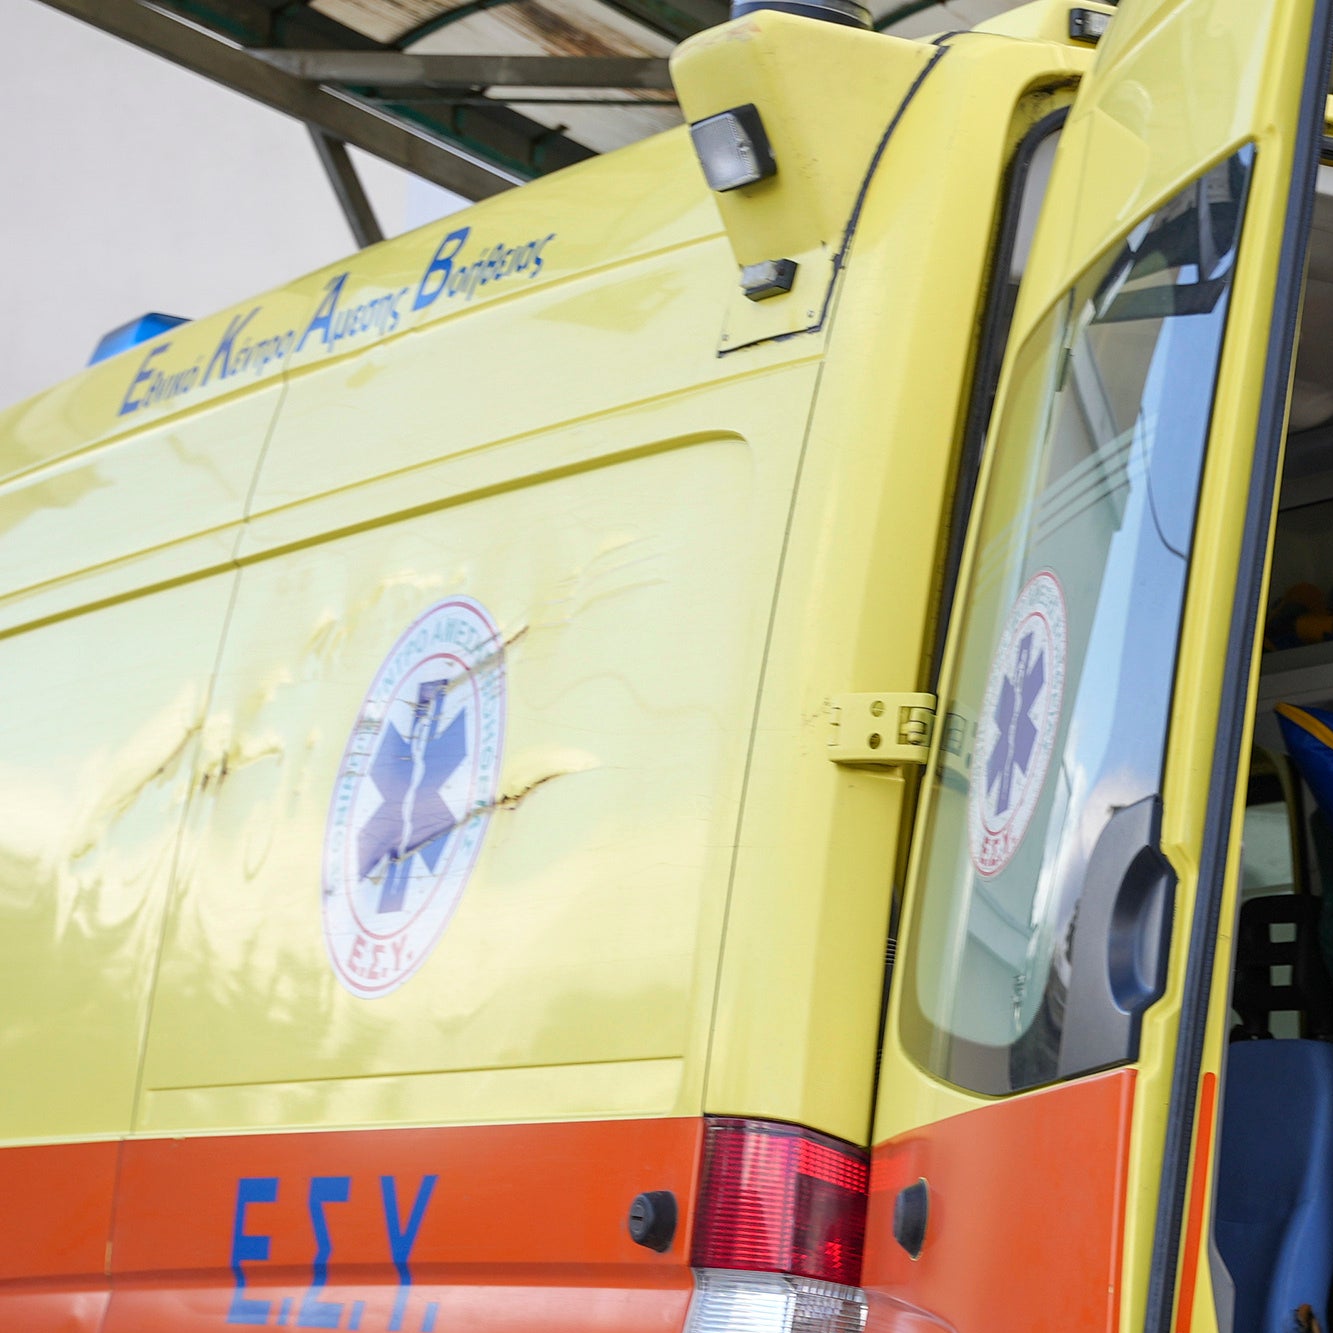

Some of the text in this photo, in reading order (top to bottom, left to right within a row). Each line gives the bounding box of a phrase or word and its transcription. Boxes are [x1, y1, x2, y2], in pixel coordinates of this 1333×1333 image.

[118, 226, 557, 417] Εθνικό Κέντρο Άμεσης Βοήθειας
[226, 1175, 441, 1333] Ε.Σ.Υ.
